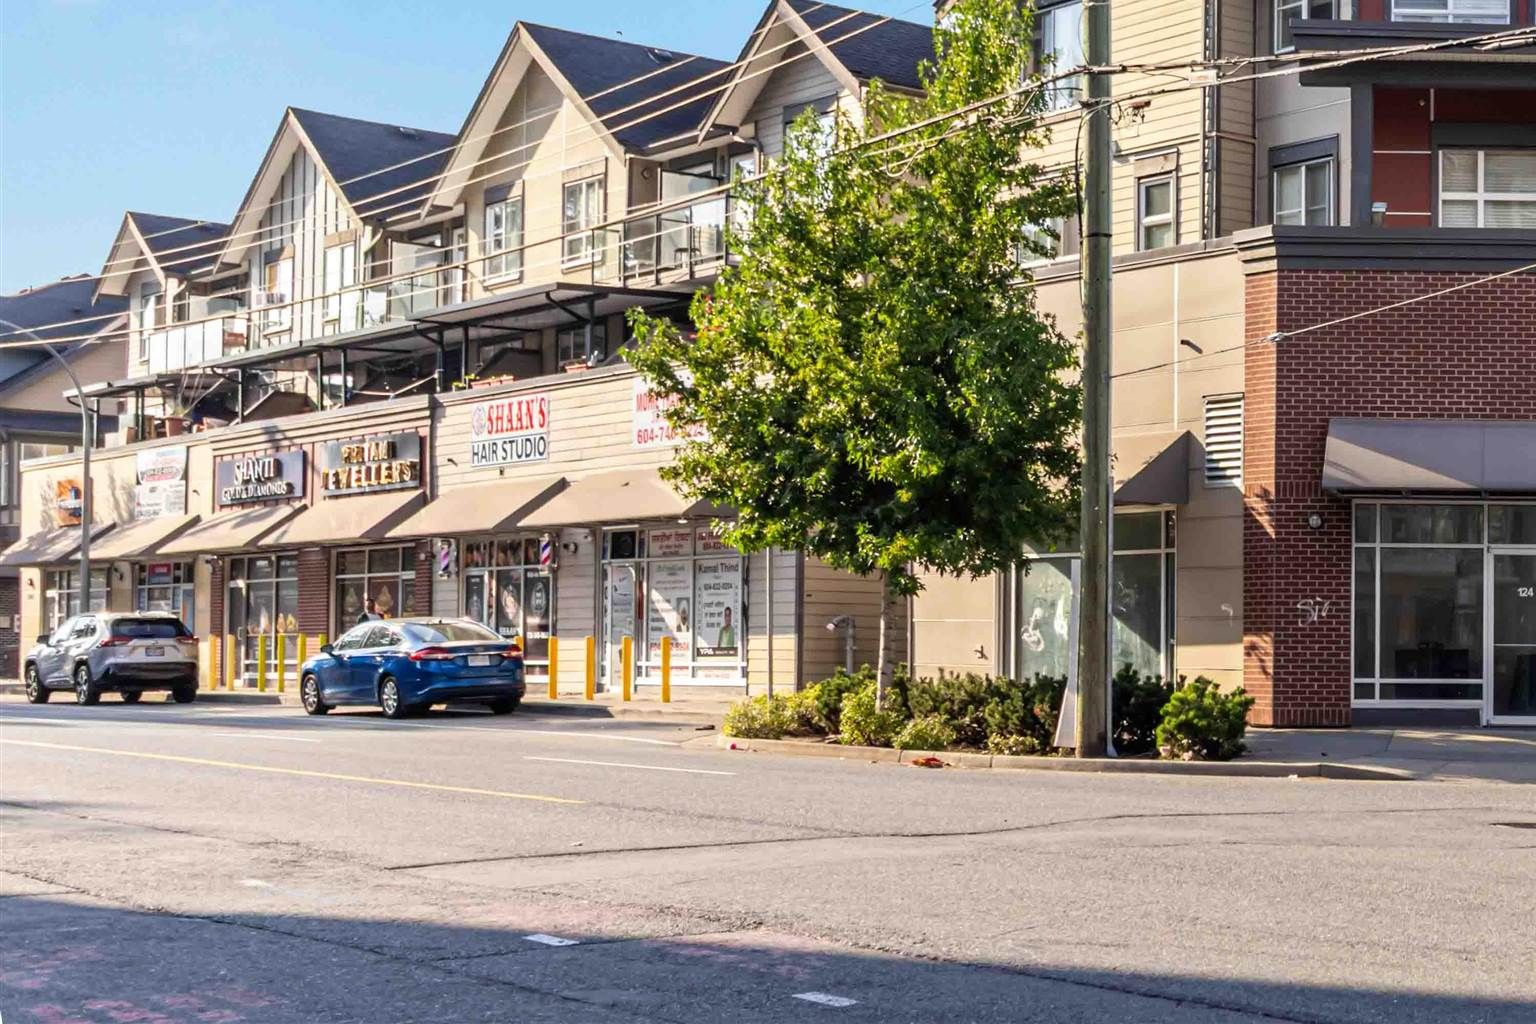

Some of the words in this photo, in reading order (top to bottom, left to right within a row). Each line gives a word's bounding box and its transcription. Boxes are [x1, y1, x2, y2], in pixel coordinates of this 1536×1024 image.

[487, 397, 546, 435] SHAAN'S
[472, 442, 498, 464] HAIR
[502, 436, 547, 461] STUDIO
[234, 457, 274, 485] SHANTI
[321, 461, 411, 490] JEWELLERS
[222, 486, 241, 501] GOLD
[1517, 587, 1534, 597] 124
